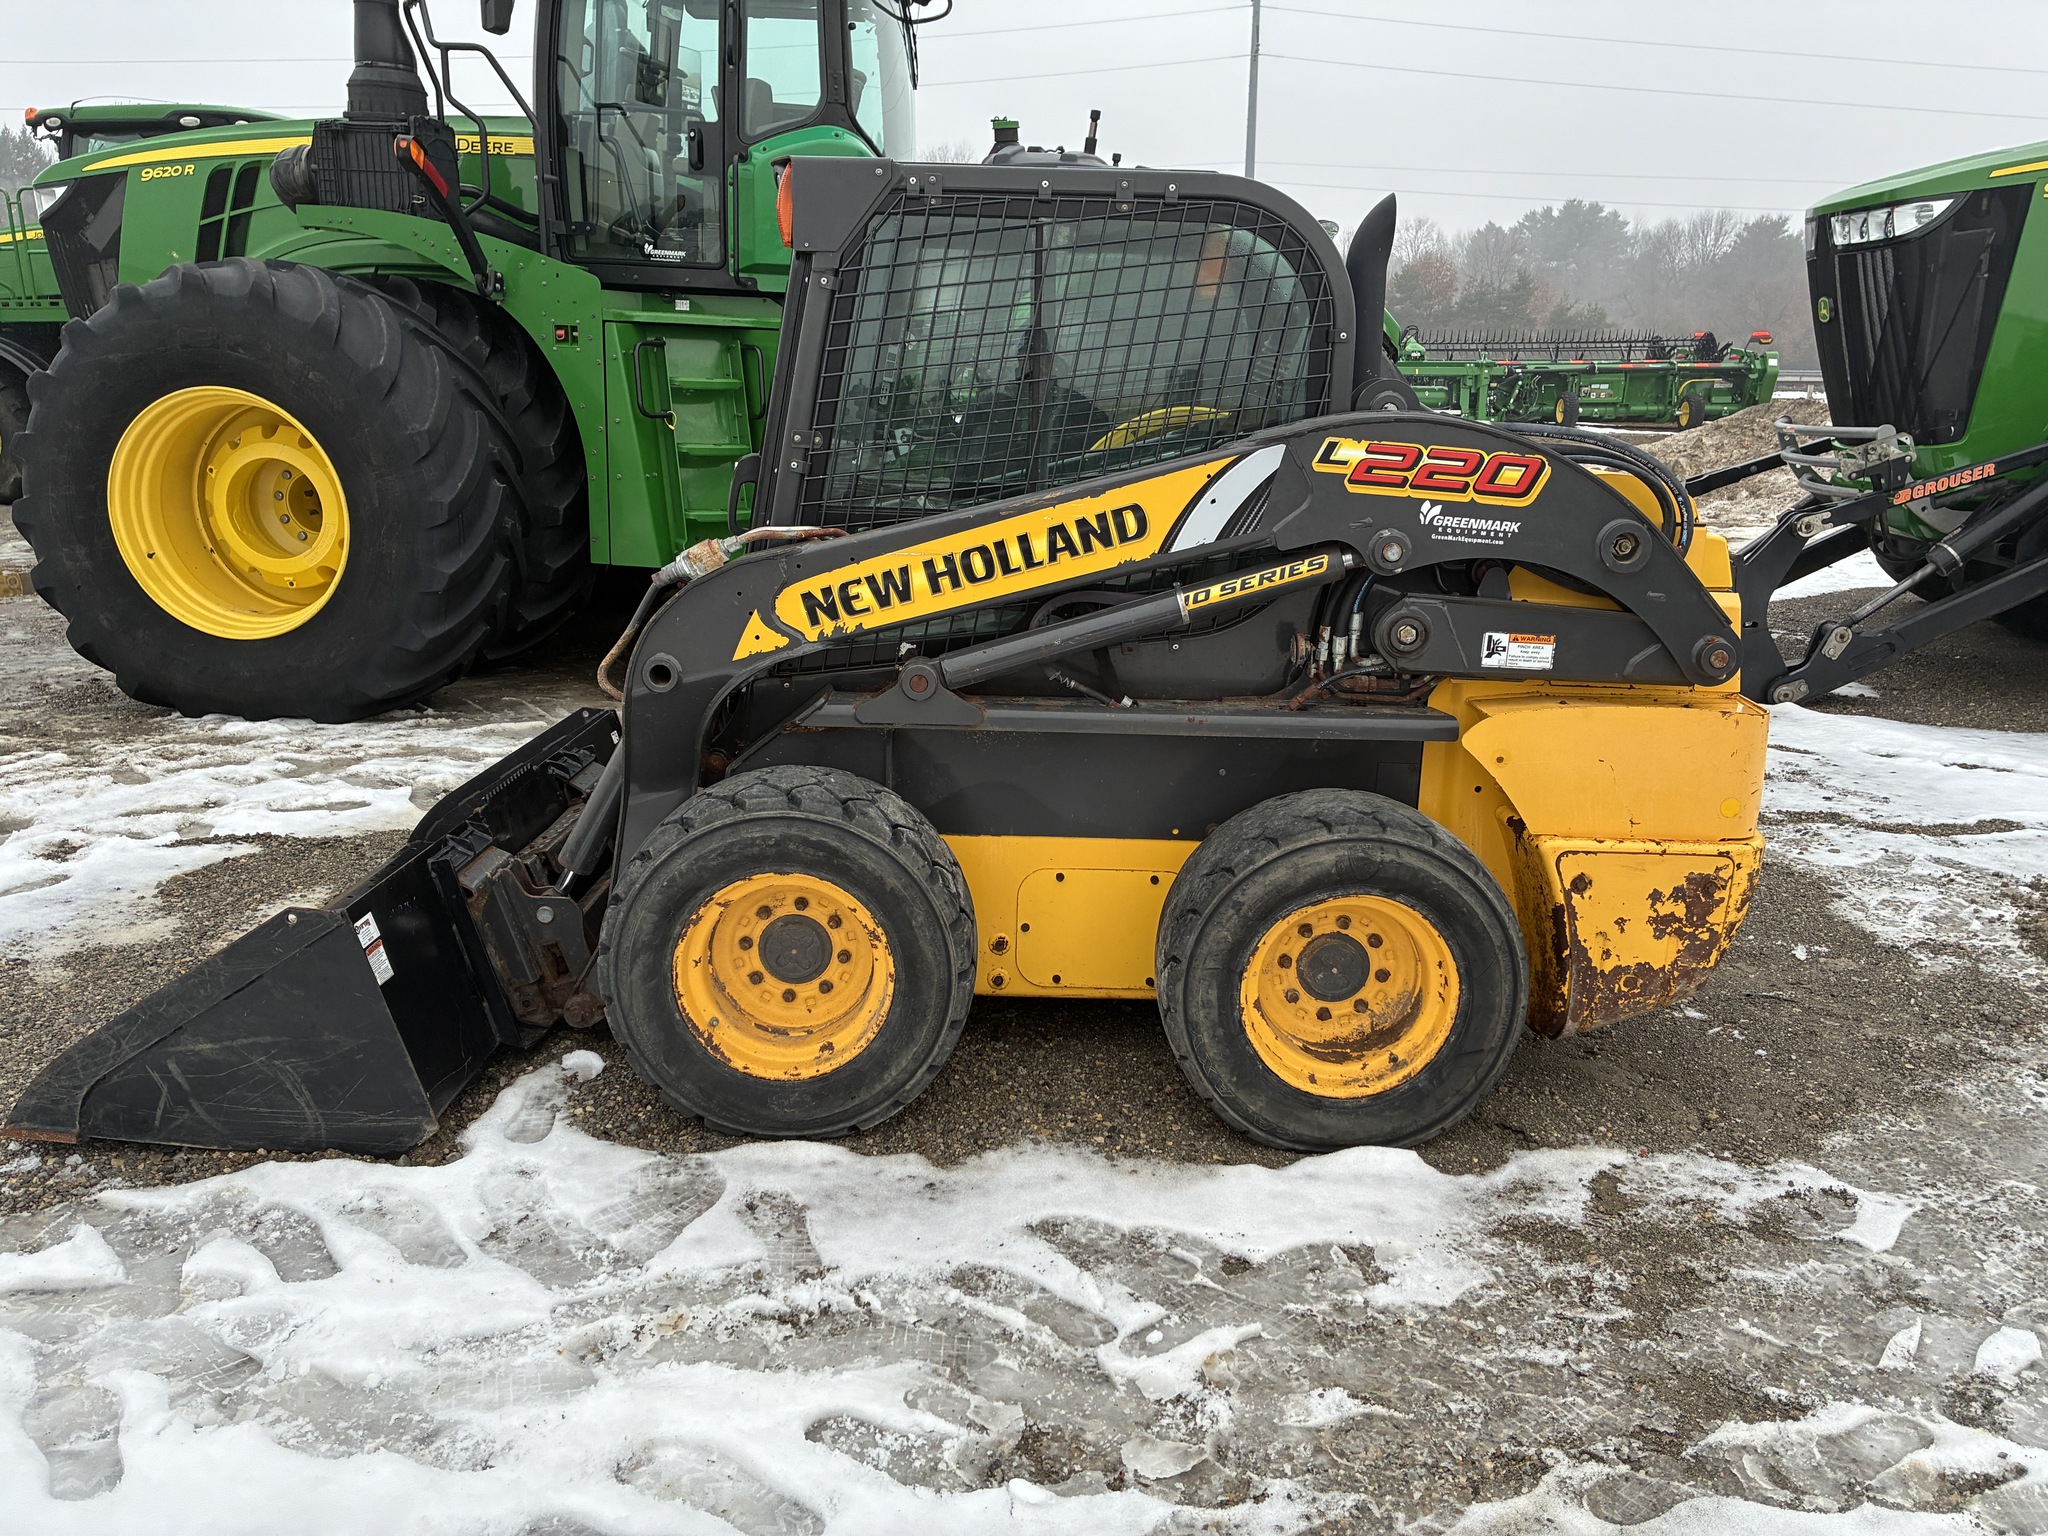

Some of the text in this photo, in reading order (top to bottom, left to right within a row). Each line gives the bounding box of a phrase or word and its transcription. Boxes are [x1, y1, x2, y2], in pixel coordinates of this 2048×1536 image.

[650, 249, 687, 257] GREENMARK
[1314, 439, 1549, 502] L220
[1913, 463, 1996, 499] GROUSER
[1432, 515, 1522, 533] GREENMARK
[1438, 527, 1513, 538] EQUIPMENT
[1431, 533, 1505, 546] GreenMarkEquipment.com
[800, 502, 1150, 628] NEW HOLLAND
[1219, 555, 1326, 598] SERIES
